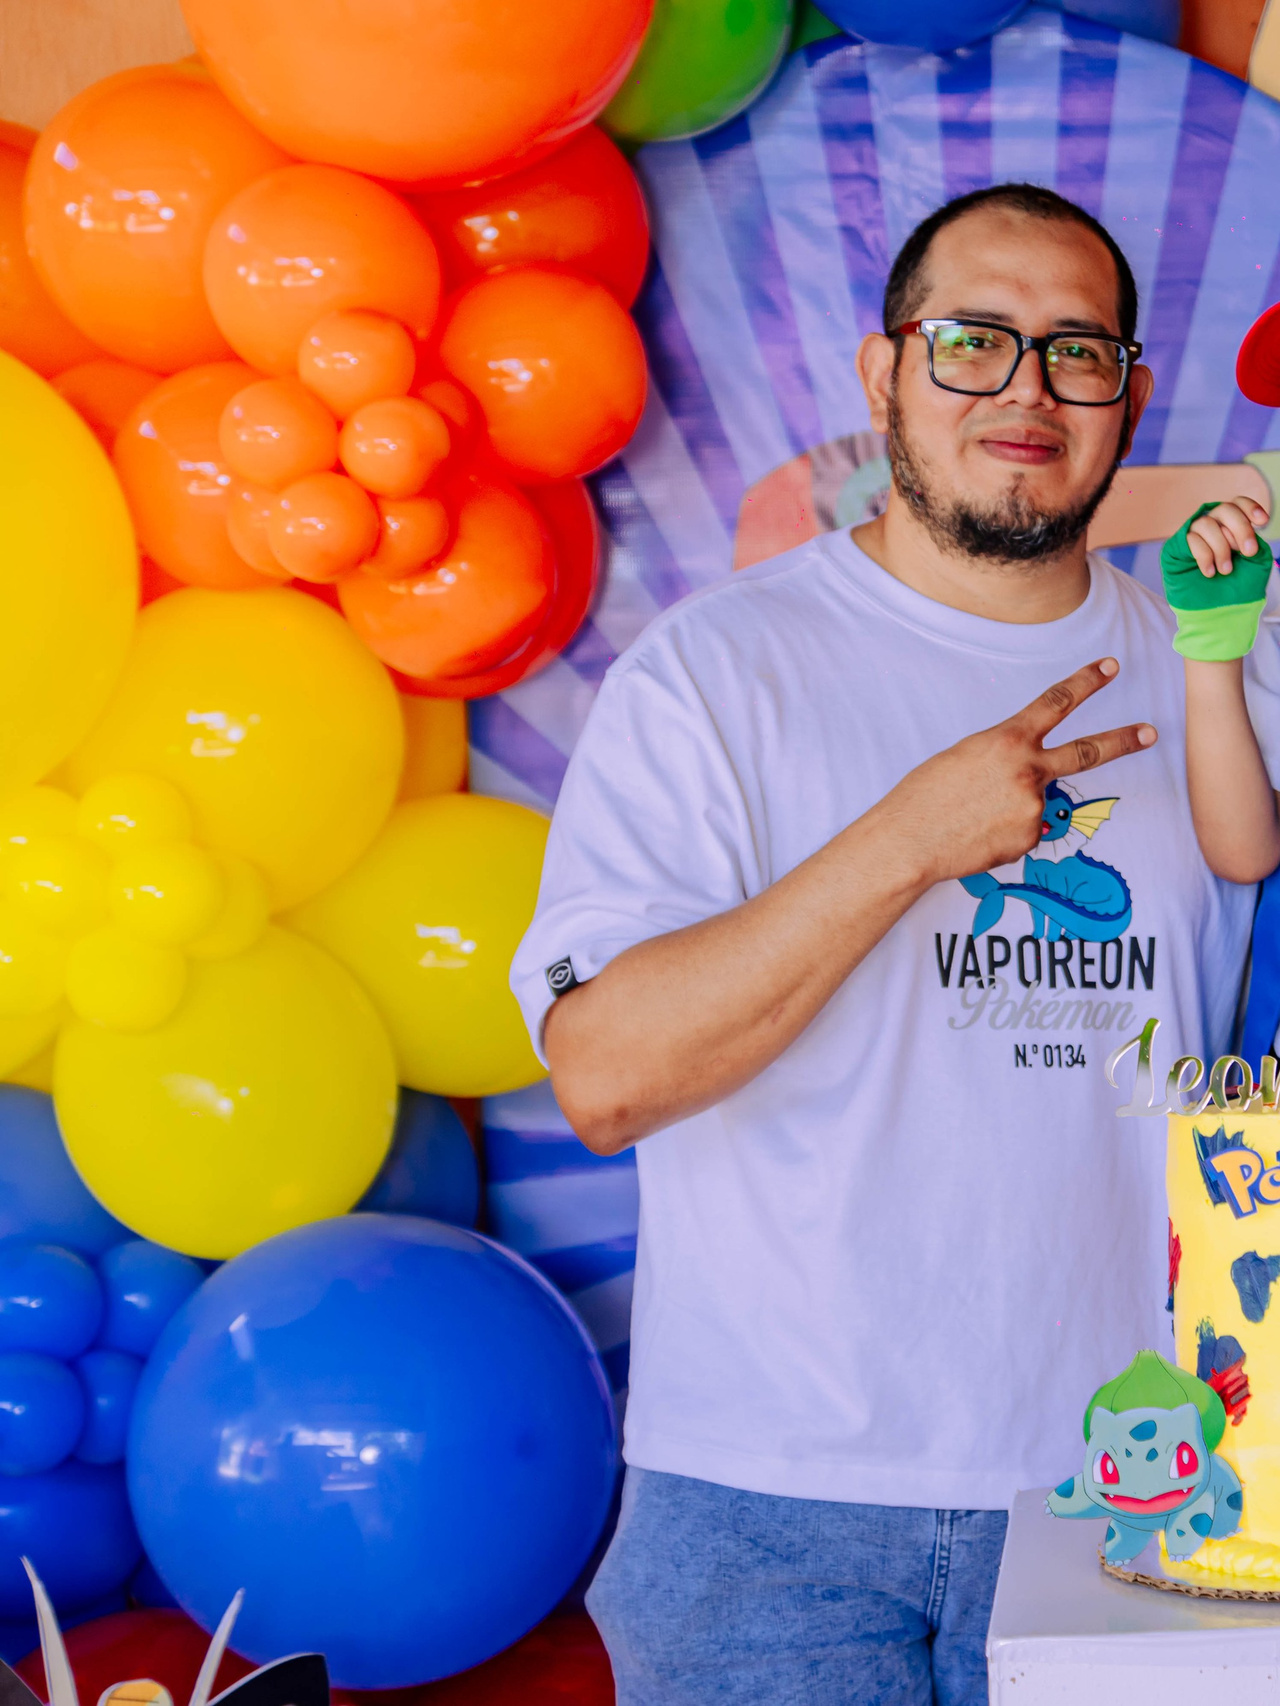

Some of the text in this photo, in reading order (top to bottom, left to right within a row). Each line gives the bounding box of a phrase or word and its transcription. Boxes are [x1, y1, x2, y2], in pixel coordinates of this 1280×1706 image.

[935, 932, 1156, 990] VAPOREON
[947, 975, 1137, 1031] Pokémon
[1043, 1043, 1087, 1068] 0134
